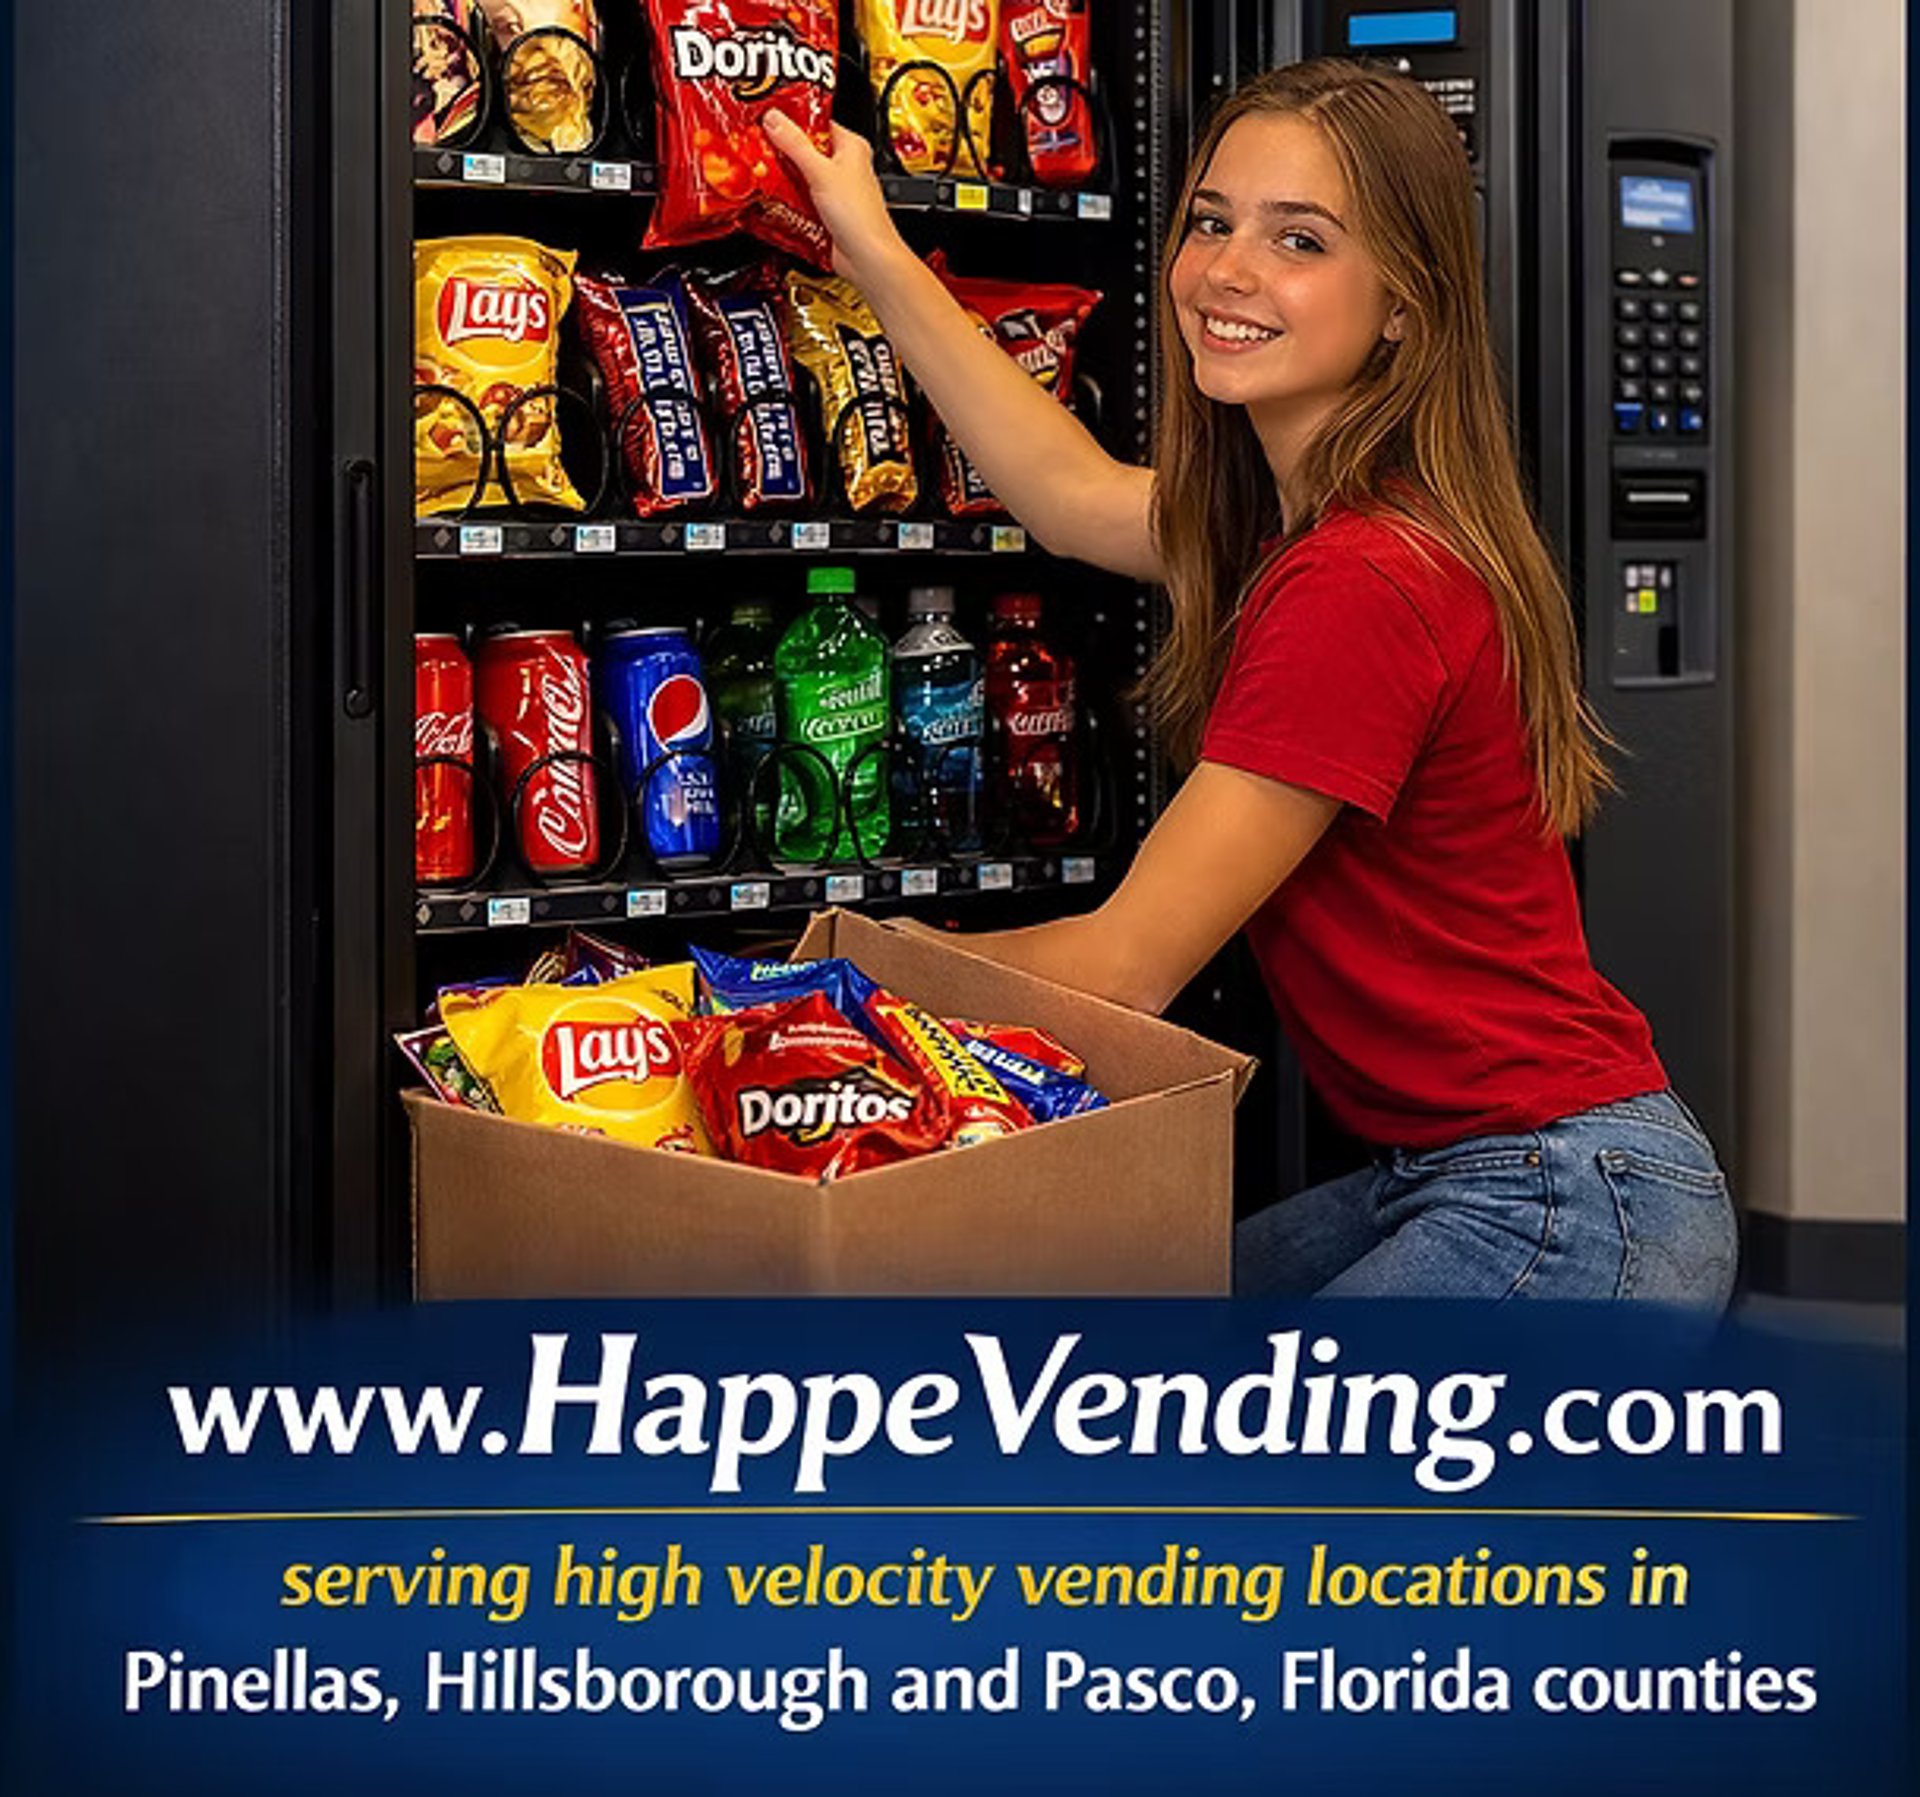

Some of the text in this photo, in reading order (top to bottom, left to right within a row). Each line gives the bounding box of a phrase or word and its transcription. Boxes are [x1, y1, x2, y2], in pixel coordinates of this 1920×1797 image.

[901, 0, 985, 45] Lays
[673, 29, 836, 90] Doritos
[556, 1018, 671, 1098] Lay's
[738, 1080, 912, 1136] Doritos
